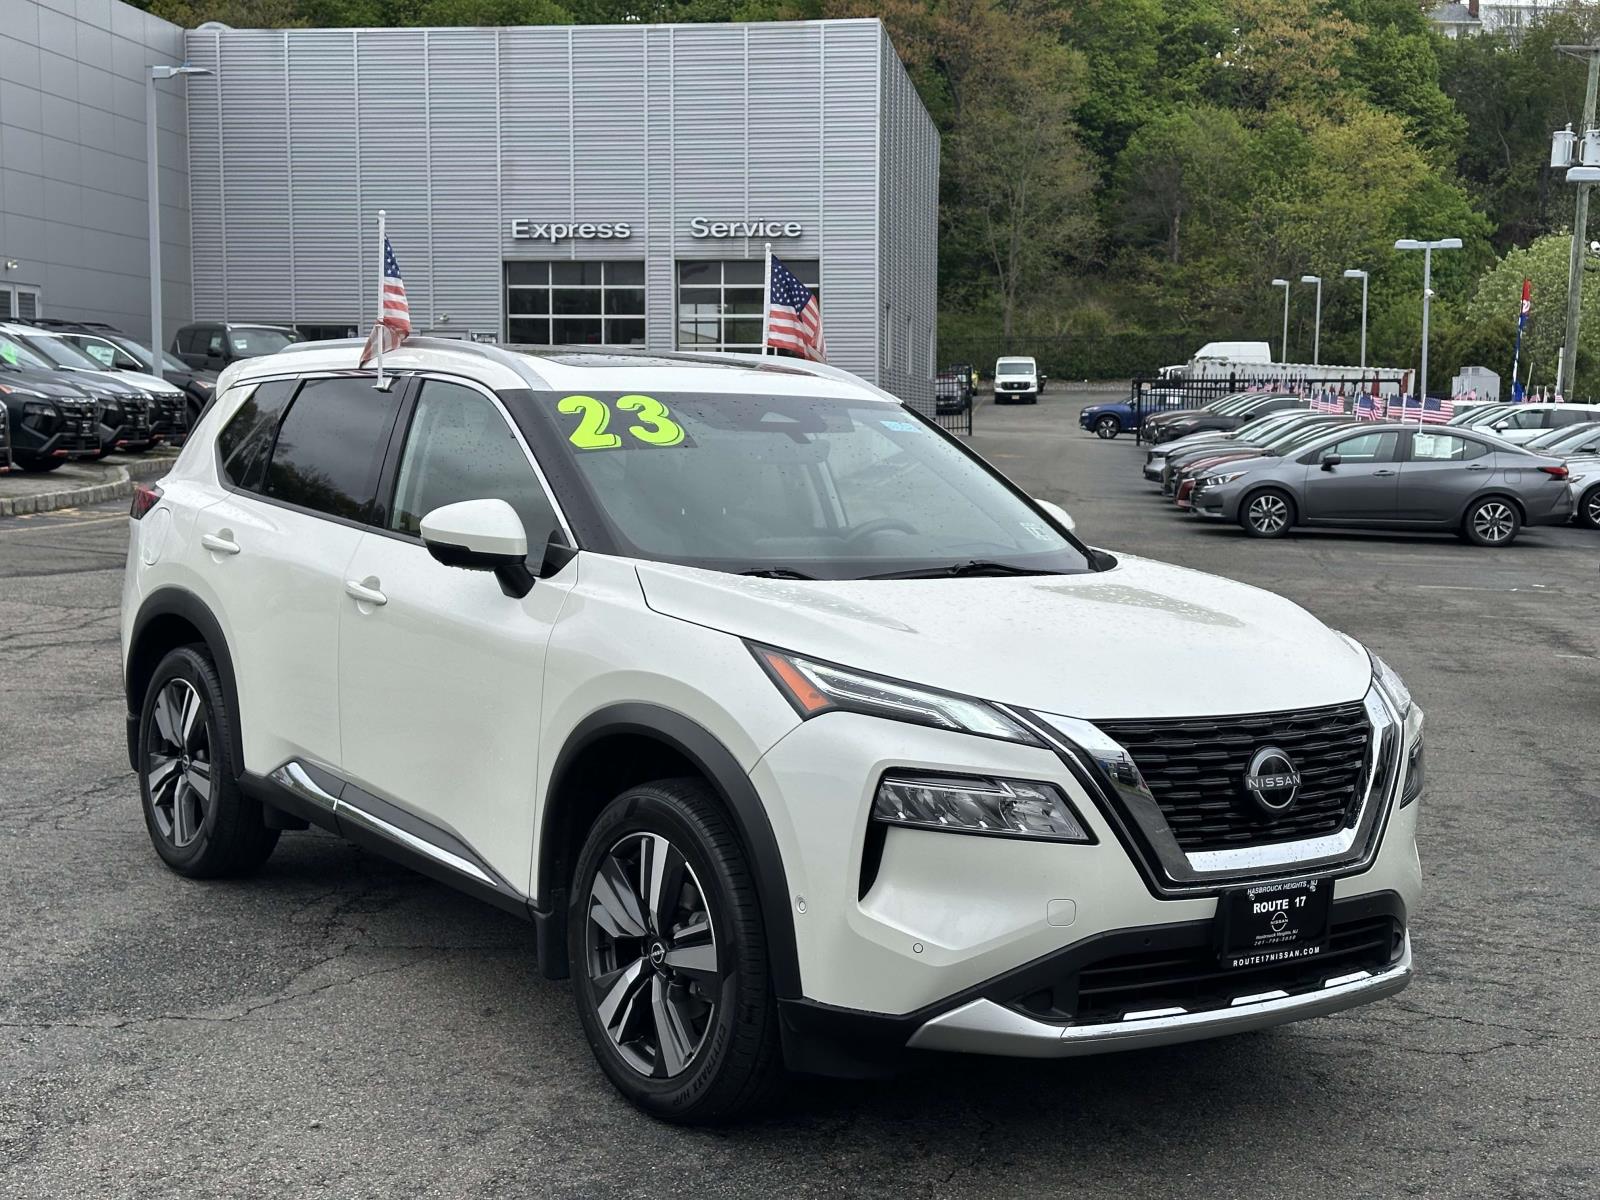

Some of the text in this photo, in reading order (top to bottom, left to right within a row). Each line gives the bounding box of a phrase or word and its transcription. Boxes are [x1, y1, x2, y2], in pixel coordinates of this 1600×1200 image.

[511, 217, 802, 243] Express Service
[557, 394, 685, 449] 23
[1248, 775, 1300, 788] NISSAN
[1247, 884, 1283, 895] HASBROUCK
[1253, 896, 1307, 913] ROUTE 17
[1232, 946, 1320, 967] ROUTE17NISSAN.COM
[692, 1023, 727, 1093] CITYTRAXX
